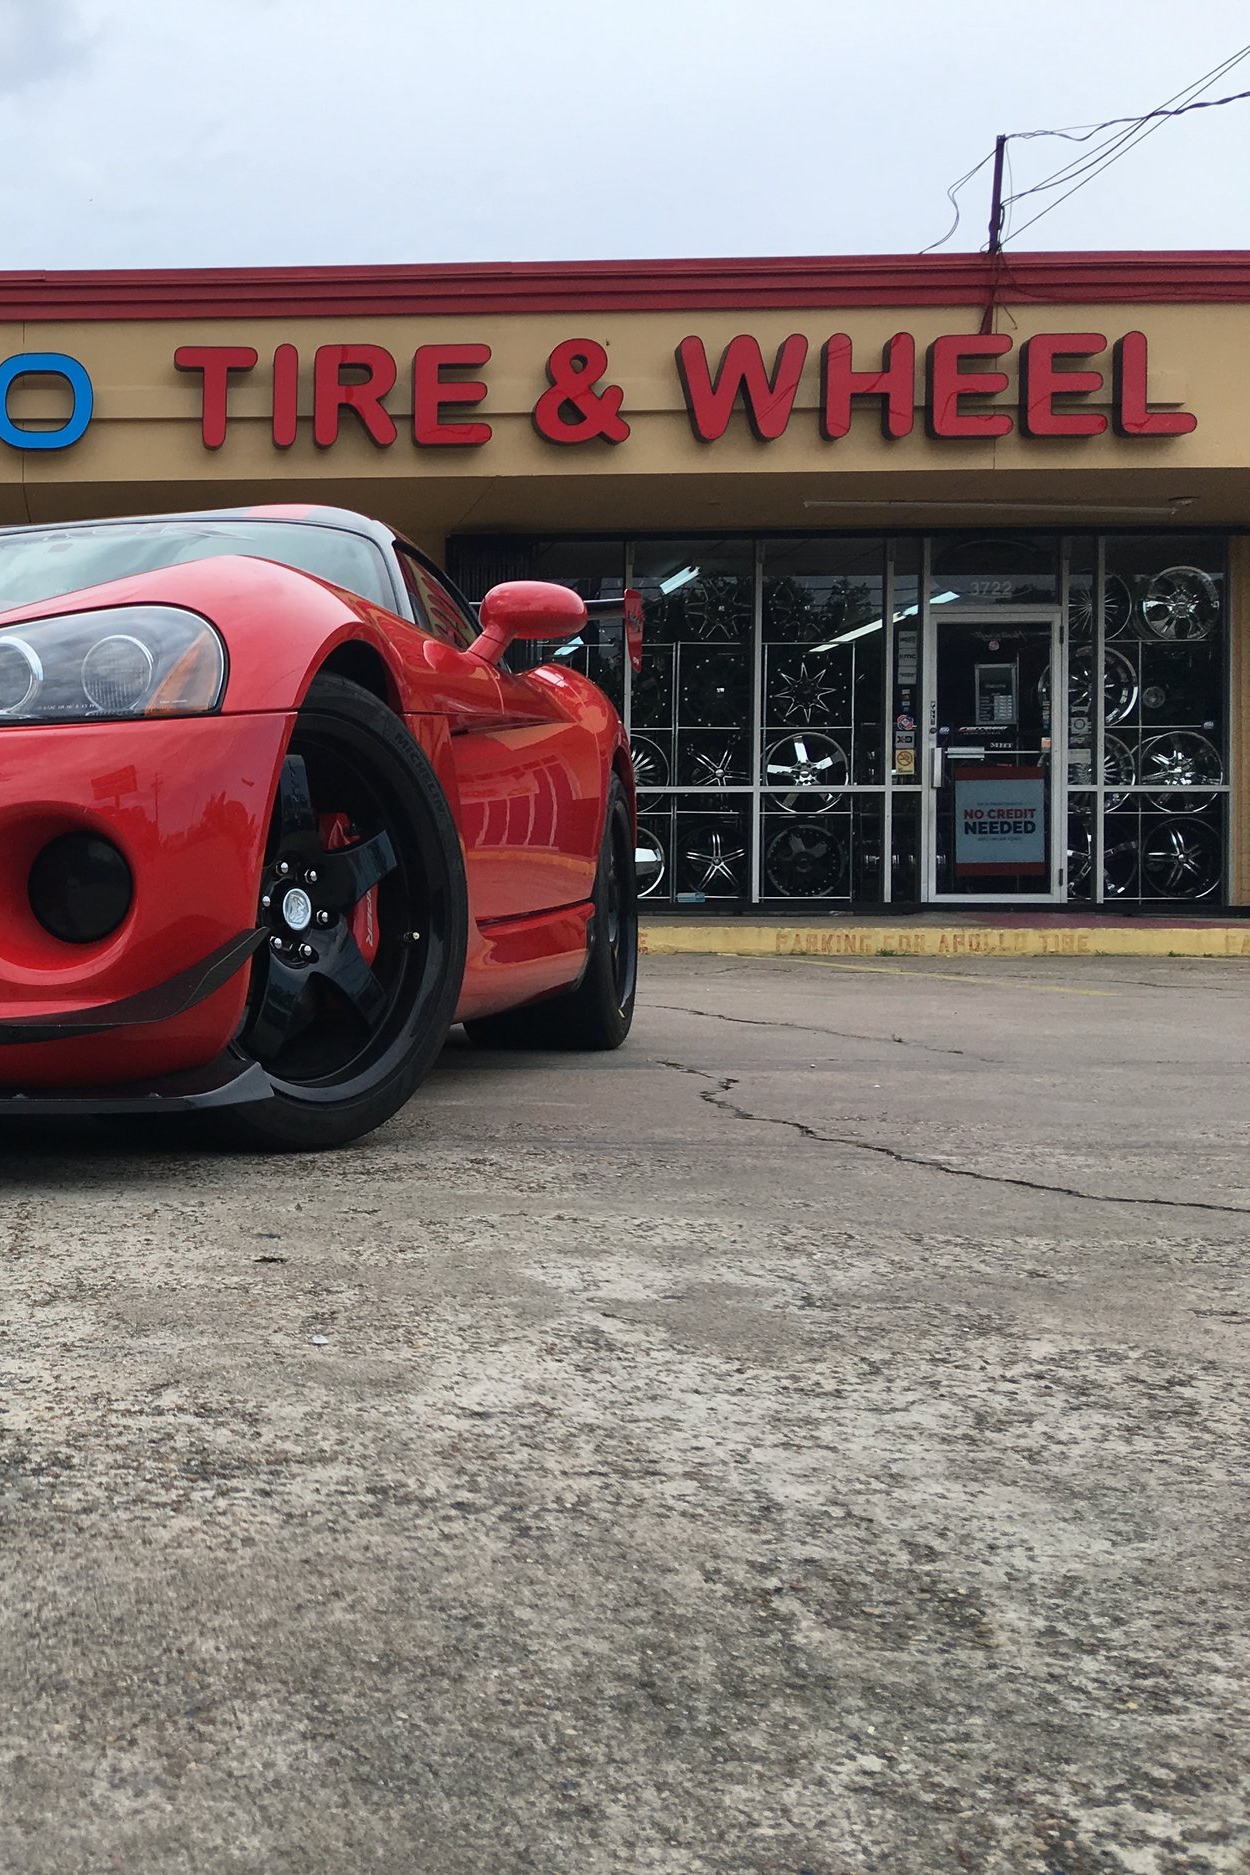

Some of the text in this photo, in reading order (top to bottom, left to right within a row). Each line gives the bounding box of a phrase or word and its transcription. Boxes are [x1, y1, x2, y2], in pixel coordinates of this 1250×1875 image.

[174, 343, 492, 450] TIRE
[532, 338, 630, 445] &
[674, 330, 1198, 443] WHEEL
[970, 581, 1012, 596] 3722
[963, 808, 1036, 820] NO CREDIT
[963, 821, 1036, 835] NEEDED
[776, 933, 872, 953] PARKING
[1038, 933, 1089, 953] TIRE
